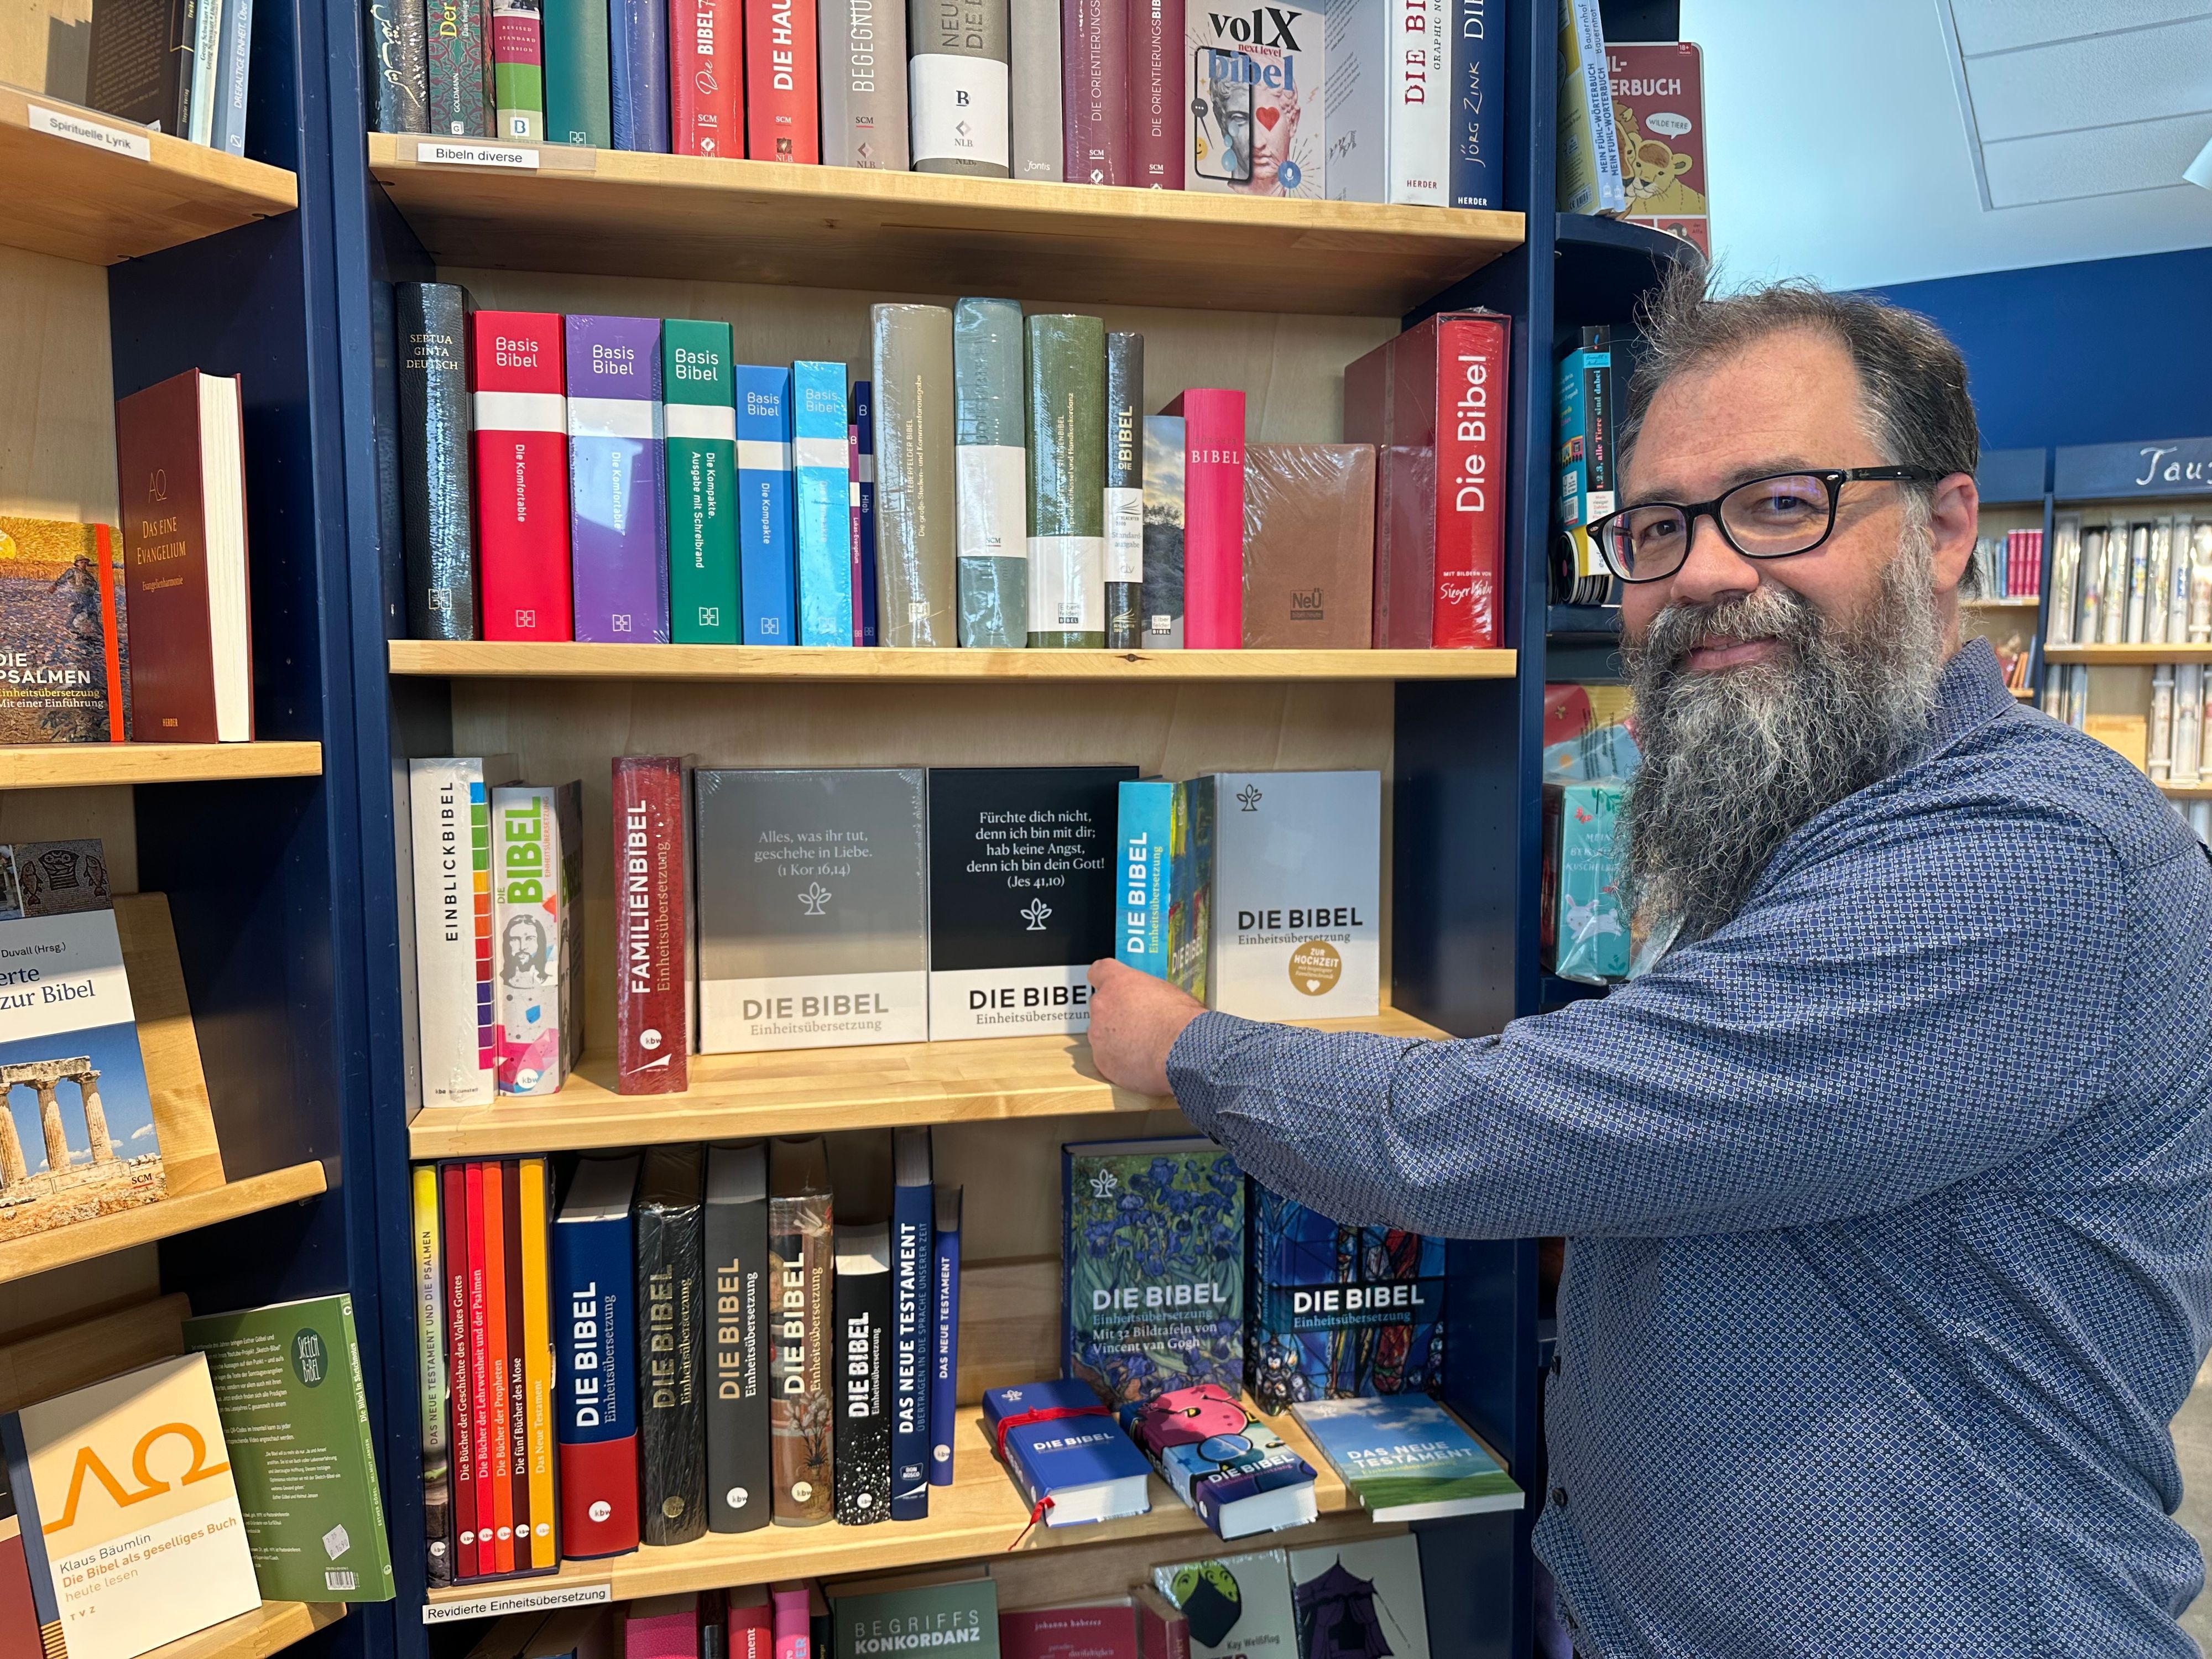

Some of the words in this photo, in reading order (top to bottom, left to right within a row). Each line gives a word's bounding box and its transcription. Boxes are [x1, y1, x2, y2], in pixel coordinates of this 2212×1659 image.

[238, 1, 248, 21] Über
[440, 2, 457, 38] Der
[236, 23, 247, 56] EINHEIT.
[697, 10, 714, 55] BIBEL
[1208, 7, 1302, 52] volX
[1238, 43, 1258, 53] next
[1260, 45, 1282, 58] level
[1433, 17, 1442, 70] GRAPHIC
[233, 57, 246, 109] DREIFALTIGE
[695, 59, 718, 95] Die
[1207, 50, 1295, 91] bibel
[697, 114, 717, 123] SCM
[775, 116, 792, 124] SCM
[855, 116, 874, 124] SCM
[1648, 119, 1670, 128] WILDE
[1671, 121, 1688, 131] TIERE
[49, 117, 103, 142] Spirituelle
[105, 132, 132, 150] Lyrik
[954, 138, 973, 148] NLB
[436, 148, 474, 160] Bibeln
[478, 150, 523, 163] diverse
[775, 154, 794, 163] NLB
[1024, 159, 1050, 171] fontis
[1406, 180, 1438, 189] HERDER
[1457, 196, 1488, 207] HERDER
[414, 347, 450, 357] GINTA
[495, 336, 539, 353] Basis
[592, 345, 635, 361] Basis
[675, 348, 719, 366] Basis
[406, 358, 458, 371] DEUTSCH
[495, 352, 538, 368] Bibel
[593, 359, 634, 375] Bibel
[675, 364, 719, 382] Bibel
[747, 392, 780, 405] Basis
[747, 404, 779, 417] Bibel
[1457, 355, 1487, 442] Bibel
[1117, 405, 1133, 462] BIBEL
[515, 444, 525, 460] Die
[1191, 450, 1240, 465] BIBEL
[1118, 462, 1133, 471] DIE
[515, 461, 525, 523] Komfortable
[760, 482, 770, 498] Die
[1456, 454, 1485, 513] Die
[861, 494, 869, 514] Hiob
[760, 499, 771, 545] Kompakte
[137, 540, 186, 566] EVANGELIUM
[1292, 588, 1322, 608] NeÜ
[0, 670, 91, 684] PSALMEN
[979, 811, 1026, 825] Fürchte
[1029, 810, 1055, 823] dich
[1057, 810, 1093, 823] nicht,
[542, 796, 551, 878] EINHEITSÜBERSETZUNG
[758, 830, 794, 845] Alles,
[797, 832, 822, 843] was
[825, 829, 844, 842] ihr
[846, 831, 868, 843] tut,
[975, 828, 1008, 841] denn
[1009, 827, 1027, 839] ich
[1030, 827, 1050, 839] bin
[1053, 827, 1073, 838] mit
[1075, 826, 1097, 839] dir;
[440, 782, 459, 941] EINBLICKBIBEL
[505, 796, 544, 904] BIBEL
[986, 843, 1010, 857] hab
[1012, 843, 1045, 855] keine
[1047, 843, 1086, 857] Angst,
[966, 860, 998, 873] denn
[1000, 860, 1019, 872] ich
[1021, 859, 1042, 872] bin
[1044, 859, 1070, 871] dein
[1072, 857, 1105, 870] Gott!
[1128, 832, 1147, 906] BIBEL
[1007, 875, 1031, 888] (Jes
[1033, 874, 1066, 889] 41,10)
[497, 887, 505, 904] DIE
[628, 800, 651, 994] FAMILIENBIBEL
[1148, 846, 1164, 954] Einheitsübersetzung
[656, 842, 671, 993] Einheitsübersetzung
[1238, 910, 1281, 930] DIE
[1288, 907, 1363, 929] BIBEL
[1126, 912, 1146, 954] DIE
[1238, 932, 1351, 946] Einheitsübersetzung
[1, 946, 33, 958] Duvall
[34, 941, 66, 955] (Hrsg.)
[1293, 954, 1339, 968] HOCHZEIT
[0, 992, 35, 1010] zur
[40, 979, 96, 1004] Bibel
[743, 997, 793, 1021] DIE
[802, 993, 889, 1018] BIBEL
[750, 1019, 882, 1037] Einheitsübersetzung
[131, 1172, 153, 1186] SCM
[899, 1223, 916, 1335] TESTAMENT
[940, 1256, 951, 1321] TESTAMENT
[717, 1258, 740, 1345] BIBEL
[782, 1252, 805, 1335] BIBEL
[1093, 1286, 1139, 1311] DIE
[1146, 1282, 1227, 1308] BIBEL
[1293, 1290, 1339, 1314] DIE
[1345, 1284, 1425, 1310] BIBEL
[649, 1264, 675, 1350] BIBEL
[1092, 1308, 1213, 1326] Einheitsübersetzung
[1293, 1311, 1411, 1328] Einheitsübersetzung
[572, 1281, 598, 1370] BIBEL
[940, 1323, 950, 1354] NEUE
[847, 1311, 870, 1376] BIBEL
[512, 1357, 521, 1383] Mose
[602, 1295, 617, 1423] Einheitsübersetzung
[783, 1340, 805, 1395] DIE
[899, 1340, 914, 1392] NEUE
[939, 1357, 948, 1379] DAS
[493, 1359, 505, 1407] Propheten
[652, 1358, 675, 1408] DIE
[719, 1352, 740, 1400] DIE
[512, 1384, 523, 1400] des
[575, 1376, 599, 1427] DIE
[847, 1378, 870, 1418] DIE
[494, 1408, 504, 1425] der
[513, 1402, 523, 1434] Bücher
[899, 1403, 914, 1435] DAS
[495, 1426, 505, 1459] Bücher
[514, 1435, 525, 1457] fünf
[1033, 1438, 1063, 1452] DIE
[1066, 1432, 1115, 1447] BIBEL
[1347, 1447, 1388, 1459] DAS
[1393, 1441, 1449, 1454] NEUE
[497, 1459, 507, 1478] Die
[515, 1458, 525, 1475] Die
[1208, 1468, 1242, 1485] DIE
[1241, 1454, 1295, 1474] BIBEL
[1353, 1447, 1473, 1469] TESTAMENT
[59, 1554, 96, 1574] Klaus
[98, 1533, 152, 1560] Bäumlin
[62, 1574, 84, 1588] Die
[86, 1558, 120, 1579] Bibel
[122, 1552, 141, 1566] als
[143, 1529, 205, 1560] geselliges
[206, 1516, 237, 1535] Buch
[65, 1582, 102, 1603] heute
[105, 1567, 139, 1587] lesen
[427, 1604, 487, 1620] Revidierte
[490, 1589, 606, 1614] Einheitsübersetzung
[855, 1609, 980, 1638] BEGRIFFS
[855, 1626, 980, 1655] KONKORDANZ
